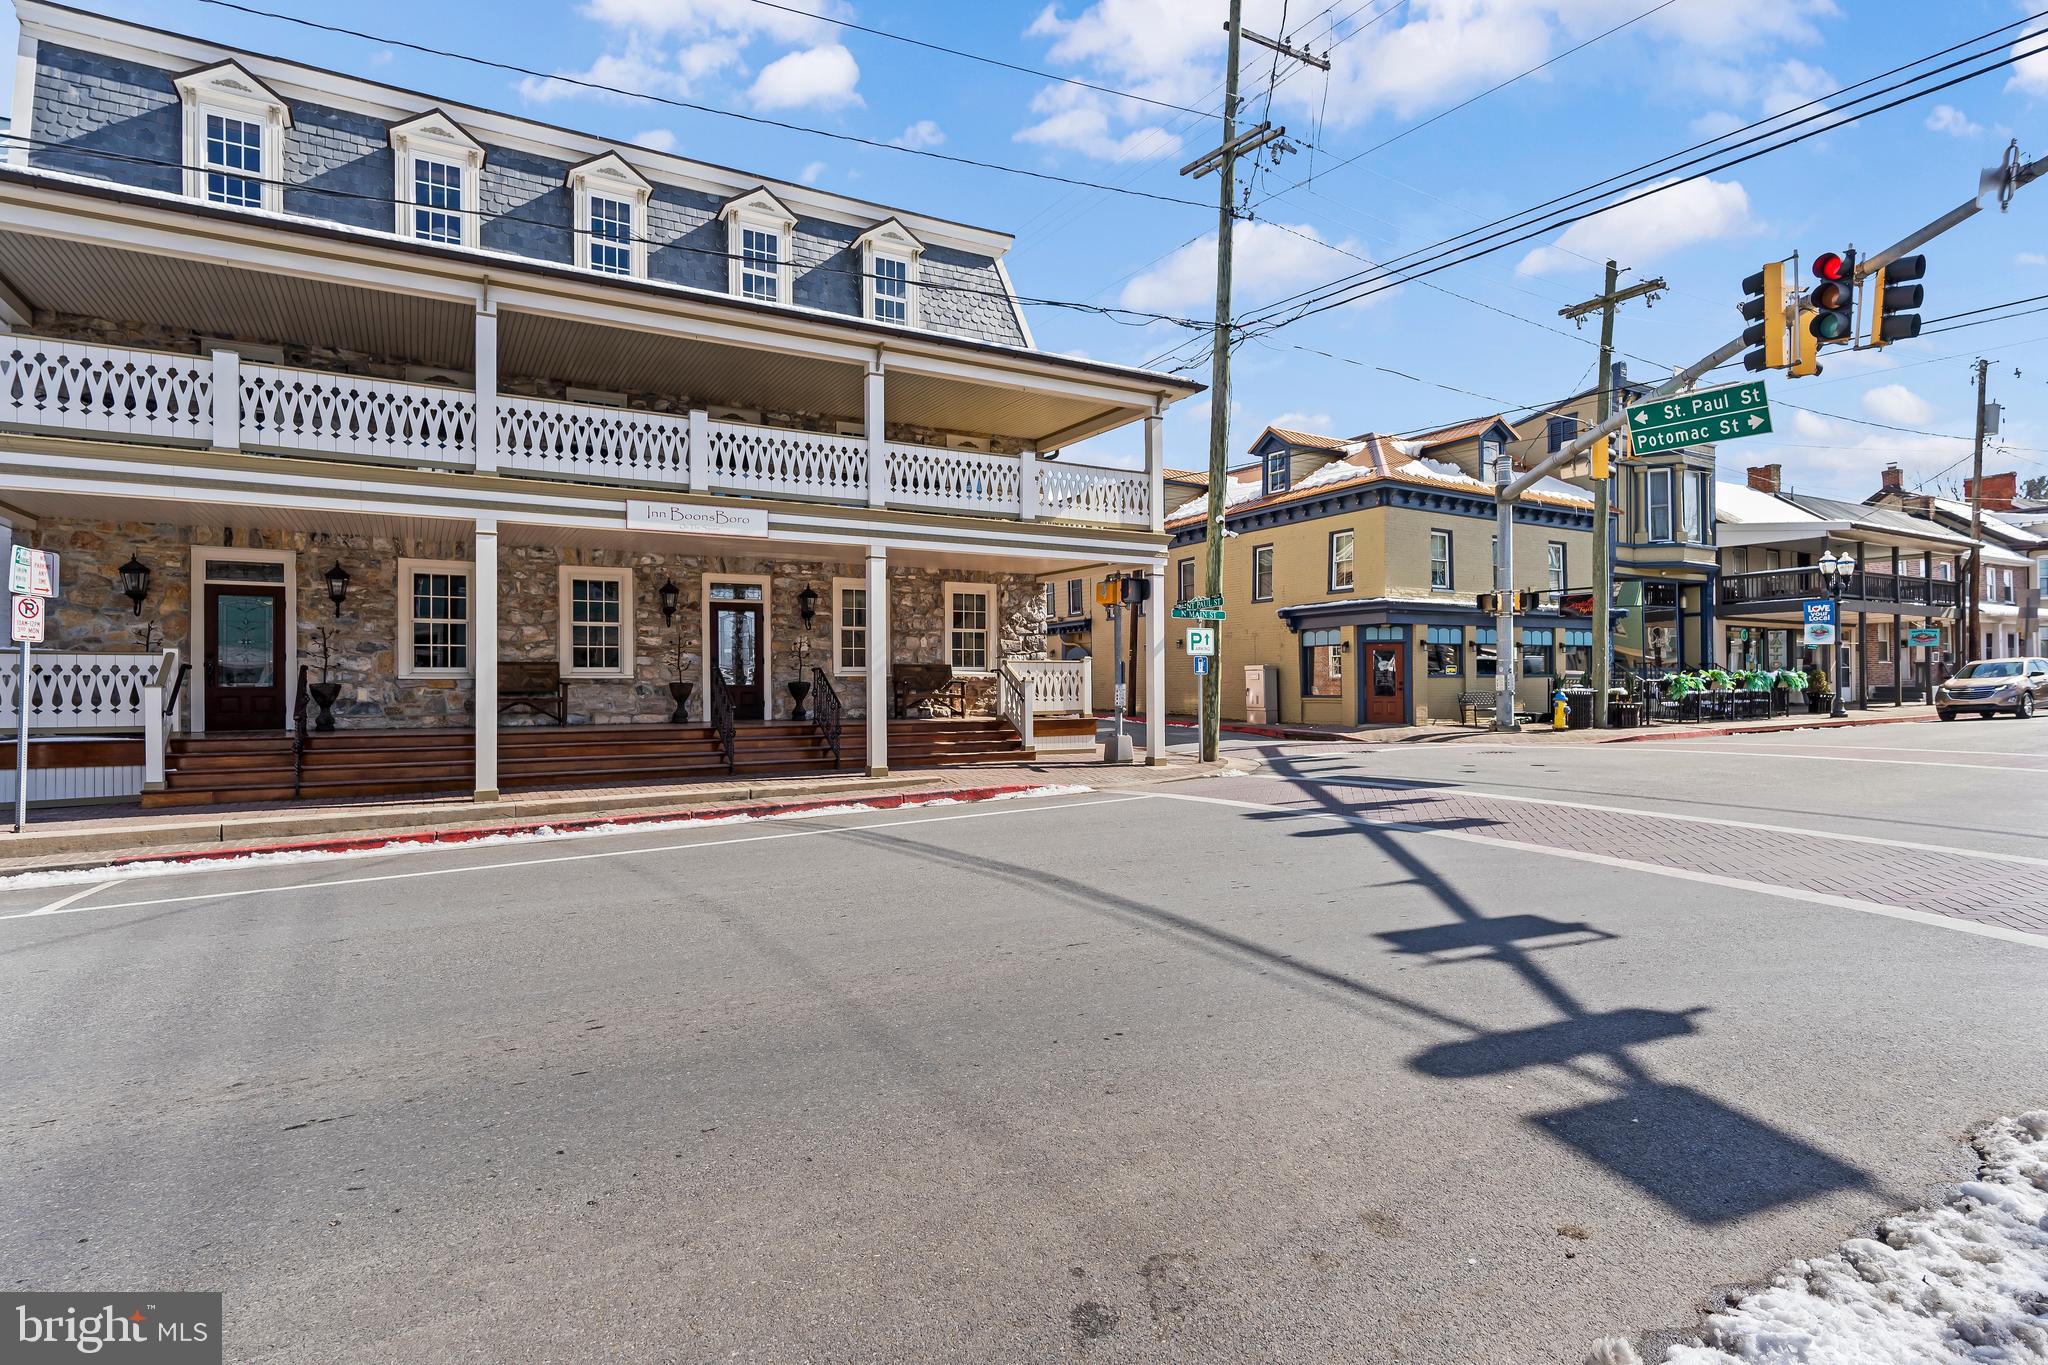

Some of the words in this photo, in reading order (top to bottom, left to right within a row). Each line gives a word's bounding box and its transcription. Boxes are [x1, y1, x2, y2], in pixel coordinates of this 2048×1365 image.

[1664, 405, 1686, 420] St.
[1692, 393, 1729, 414] Paul
[1740, 388, 1761, 404] St
[1637, 427, 1710, 449] Potomac
[1719, 418, 1740, 435] St
[647, 505, 667, 519] Inn
[670, 506, 750, 525] BoonsBoro
[1196, 600, 1211, 609] PAUL
[1213, 598, 1221, 606] ST
[1807, 604, 1831, 613] LOVE
